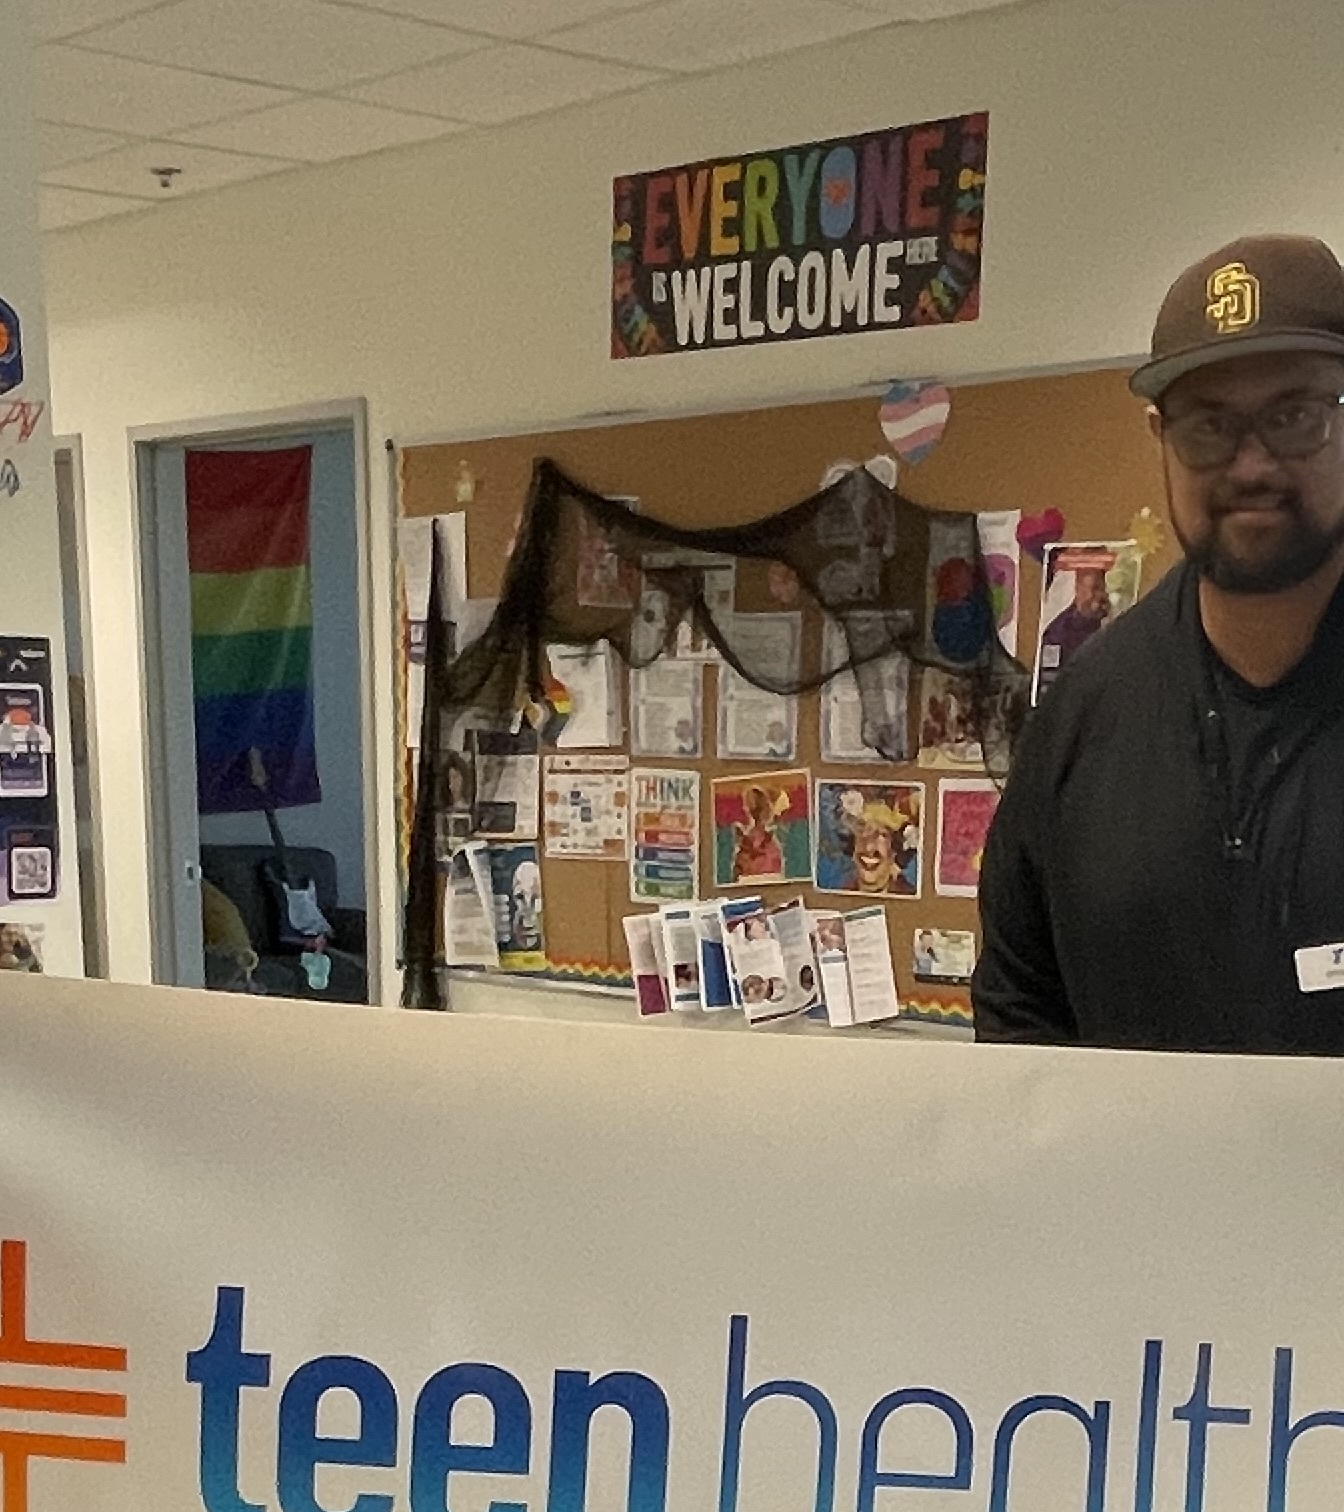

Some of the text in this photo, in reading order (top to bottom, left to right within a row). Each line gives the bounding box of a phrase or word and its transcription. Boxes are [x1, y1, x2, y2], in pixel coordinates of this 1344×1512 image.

[642, 126, 945, 265] EVERYONE
[671, 240, 904, 346] WELCOME
[635, 775, 695, 802] THINK
